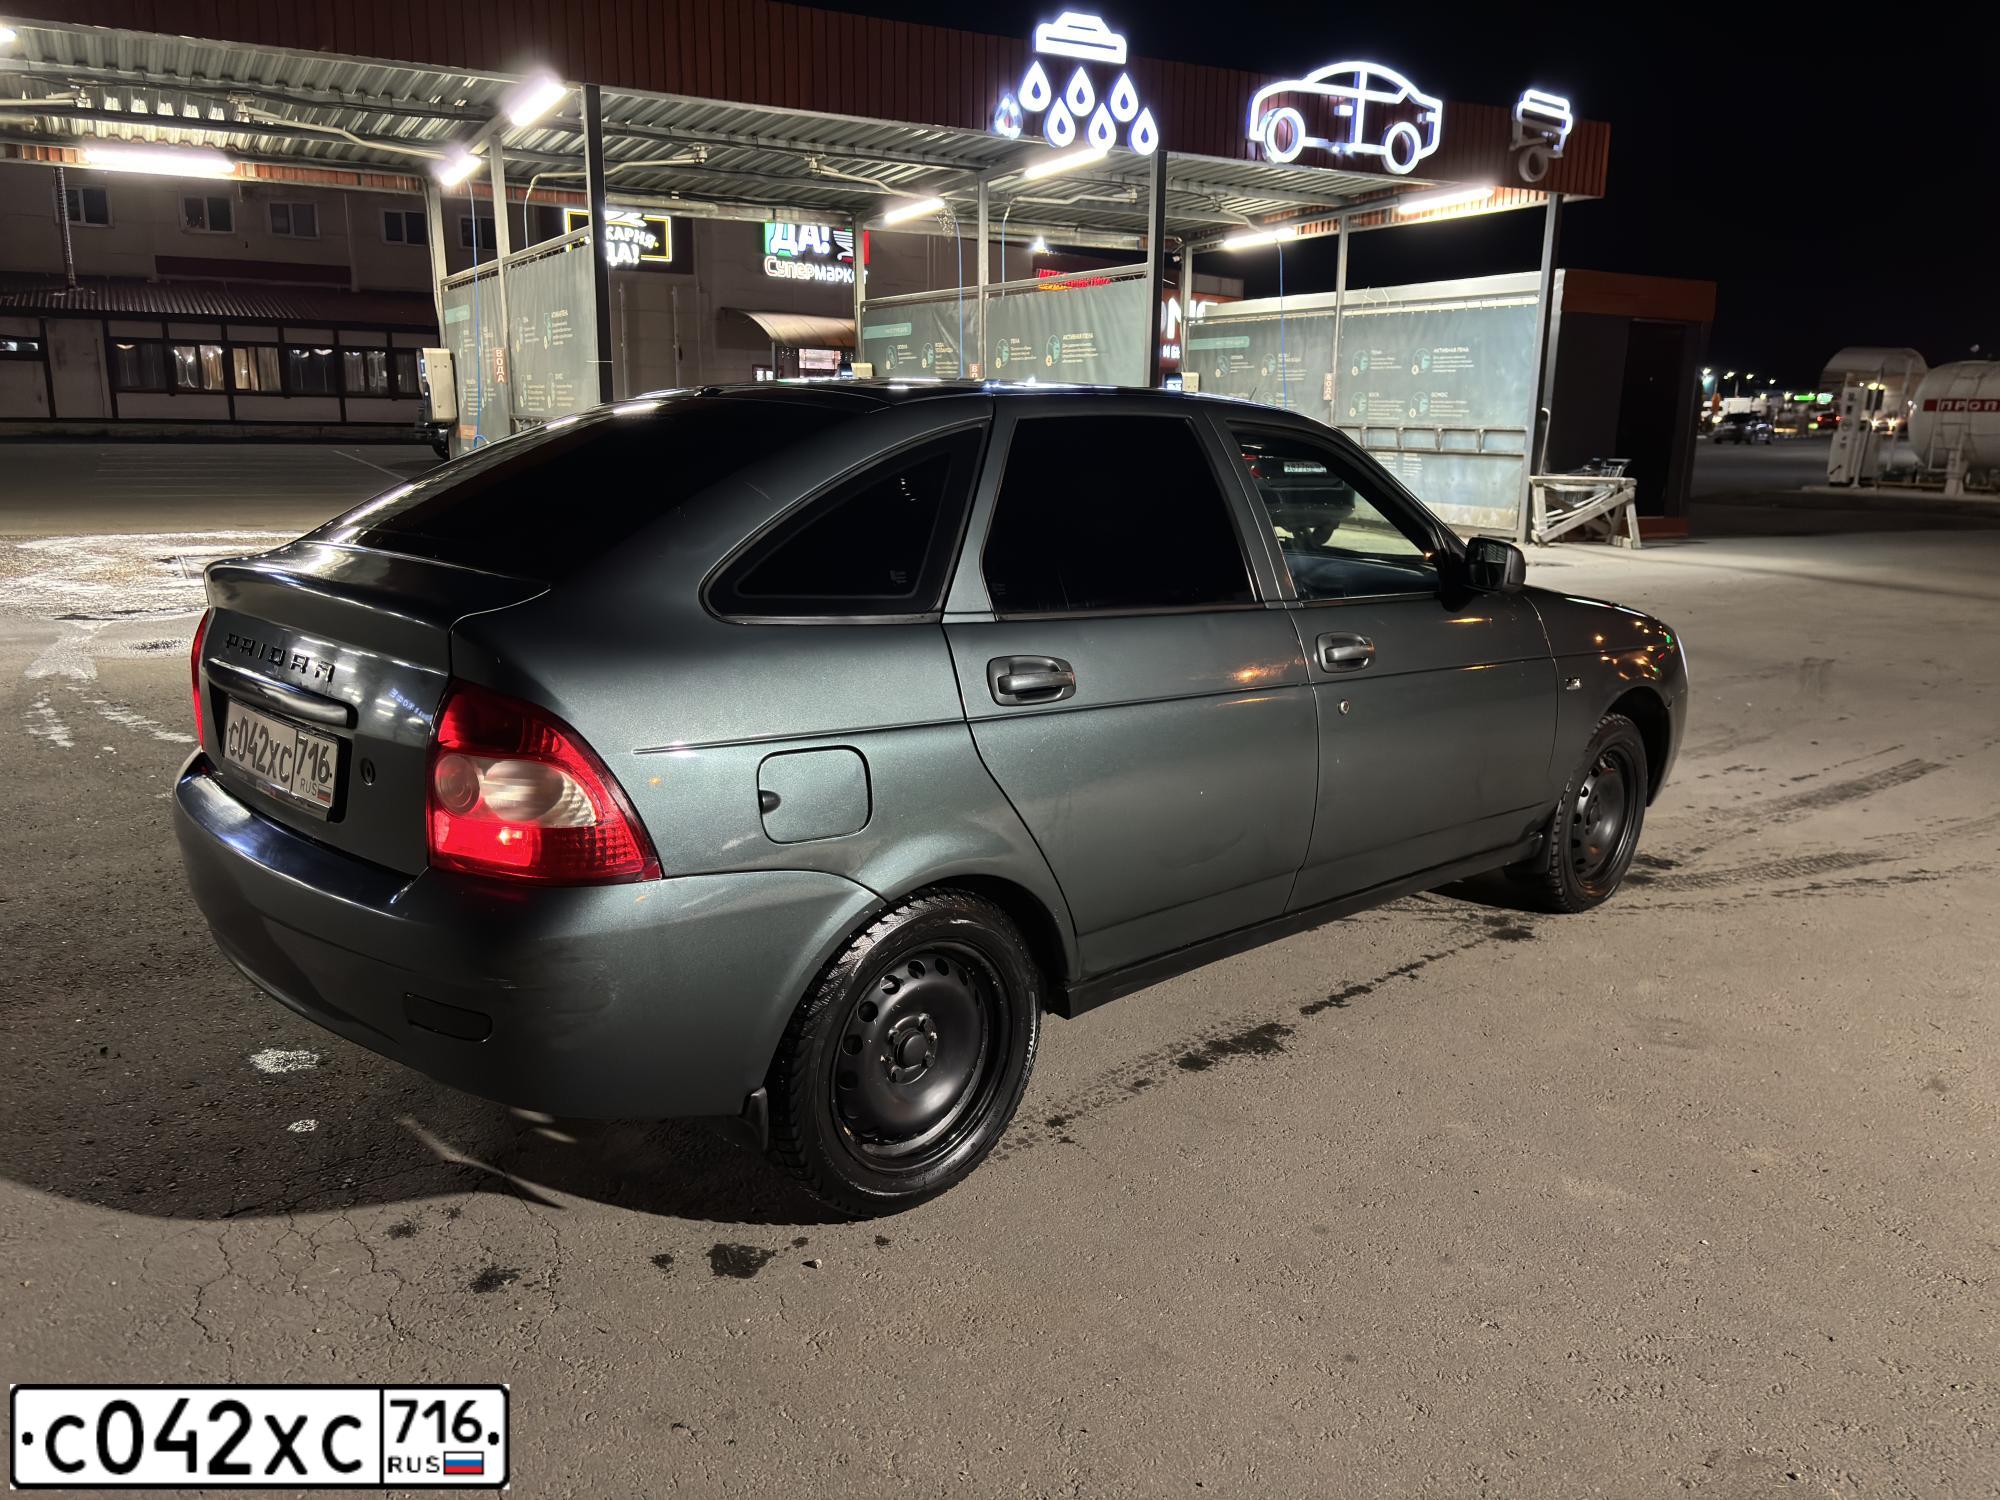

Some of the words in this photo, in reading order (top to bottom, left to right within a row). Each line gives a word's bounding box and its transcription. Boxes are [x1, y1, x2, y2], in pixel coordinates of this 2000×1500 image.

[606, 226, 652, 249] КАРНЯ
[764, 255, 869, 286] Супермаркт
[495, 349, 505, 383] ВОДА
[226, 633, 335, 683] PRIORA
[296, 735, 332, 785] 716
[300, 777, 318, 797] RUS
